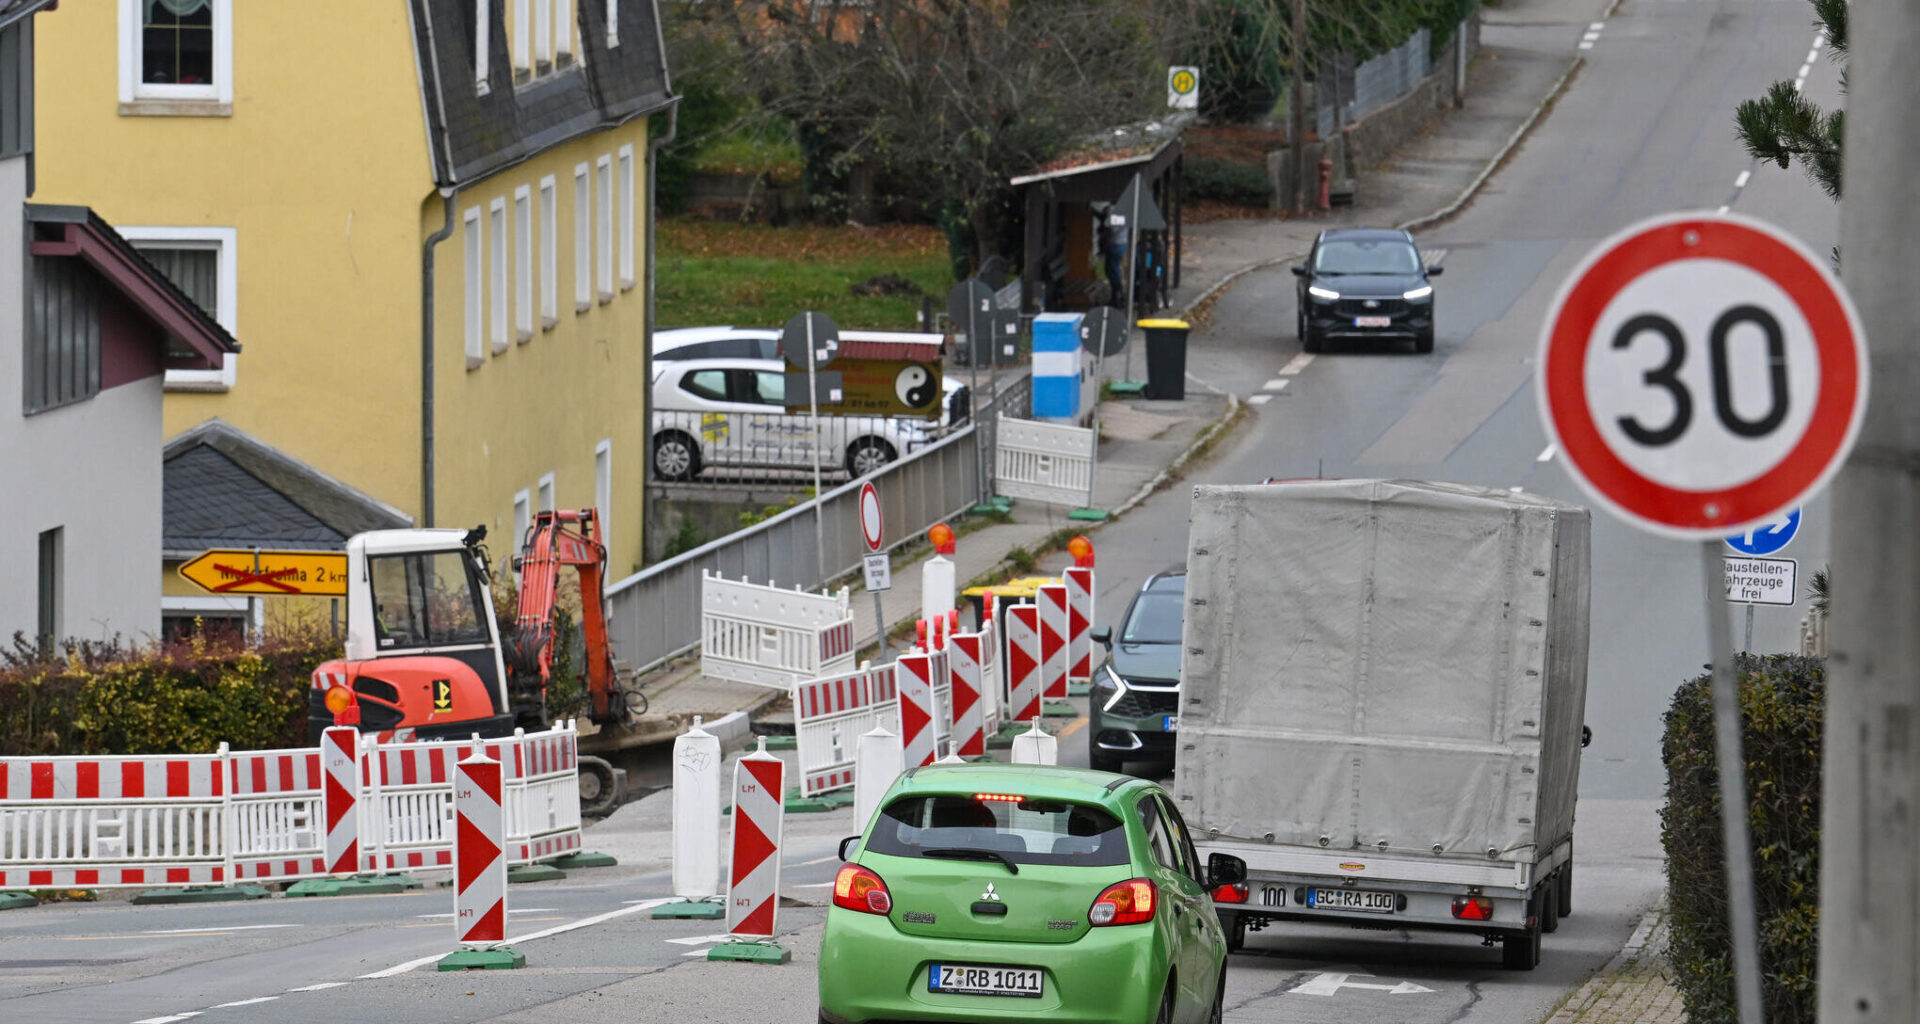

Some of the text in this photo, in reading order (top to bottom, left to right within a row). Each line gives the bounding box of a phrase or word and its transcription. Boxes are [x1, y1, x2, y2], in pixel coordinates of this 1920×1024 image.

[1611, 303, 1790, 448] 30
[316, 567, 326, 583] 2
[1741, 587, 1762, 599] frei
[457, 790, 472, 799] LM
[742, 784, 756, 793] LM
[1261, 887, 1287, 908] 100
[1315, 890, 1335, 905] GC
[1343, 892, 1362, 907] RA
[1365, 894, 1392, 909] 100
[942, 968, 954, 986] Z
[966, 969, 990, 988] RB
[993, 971, 1039, 990] 1011
